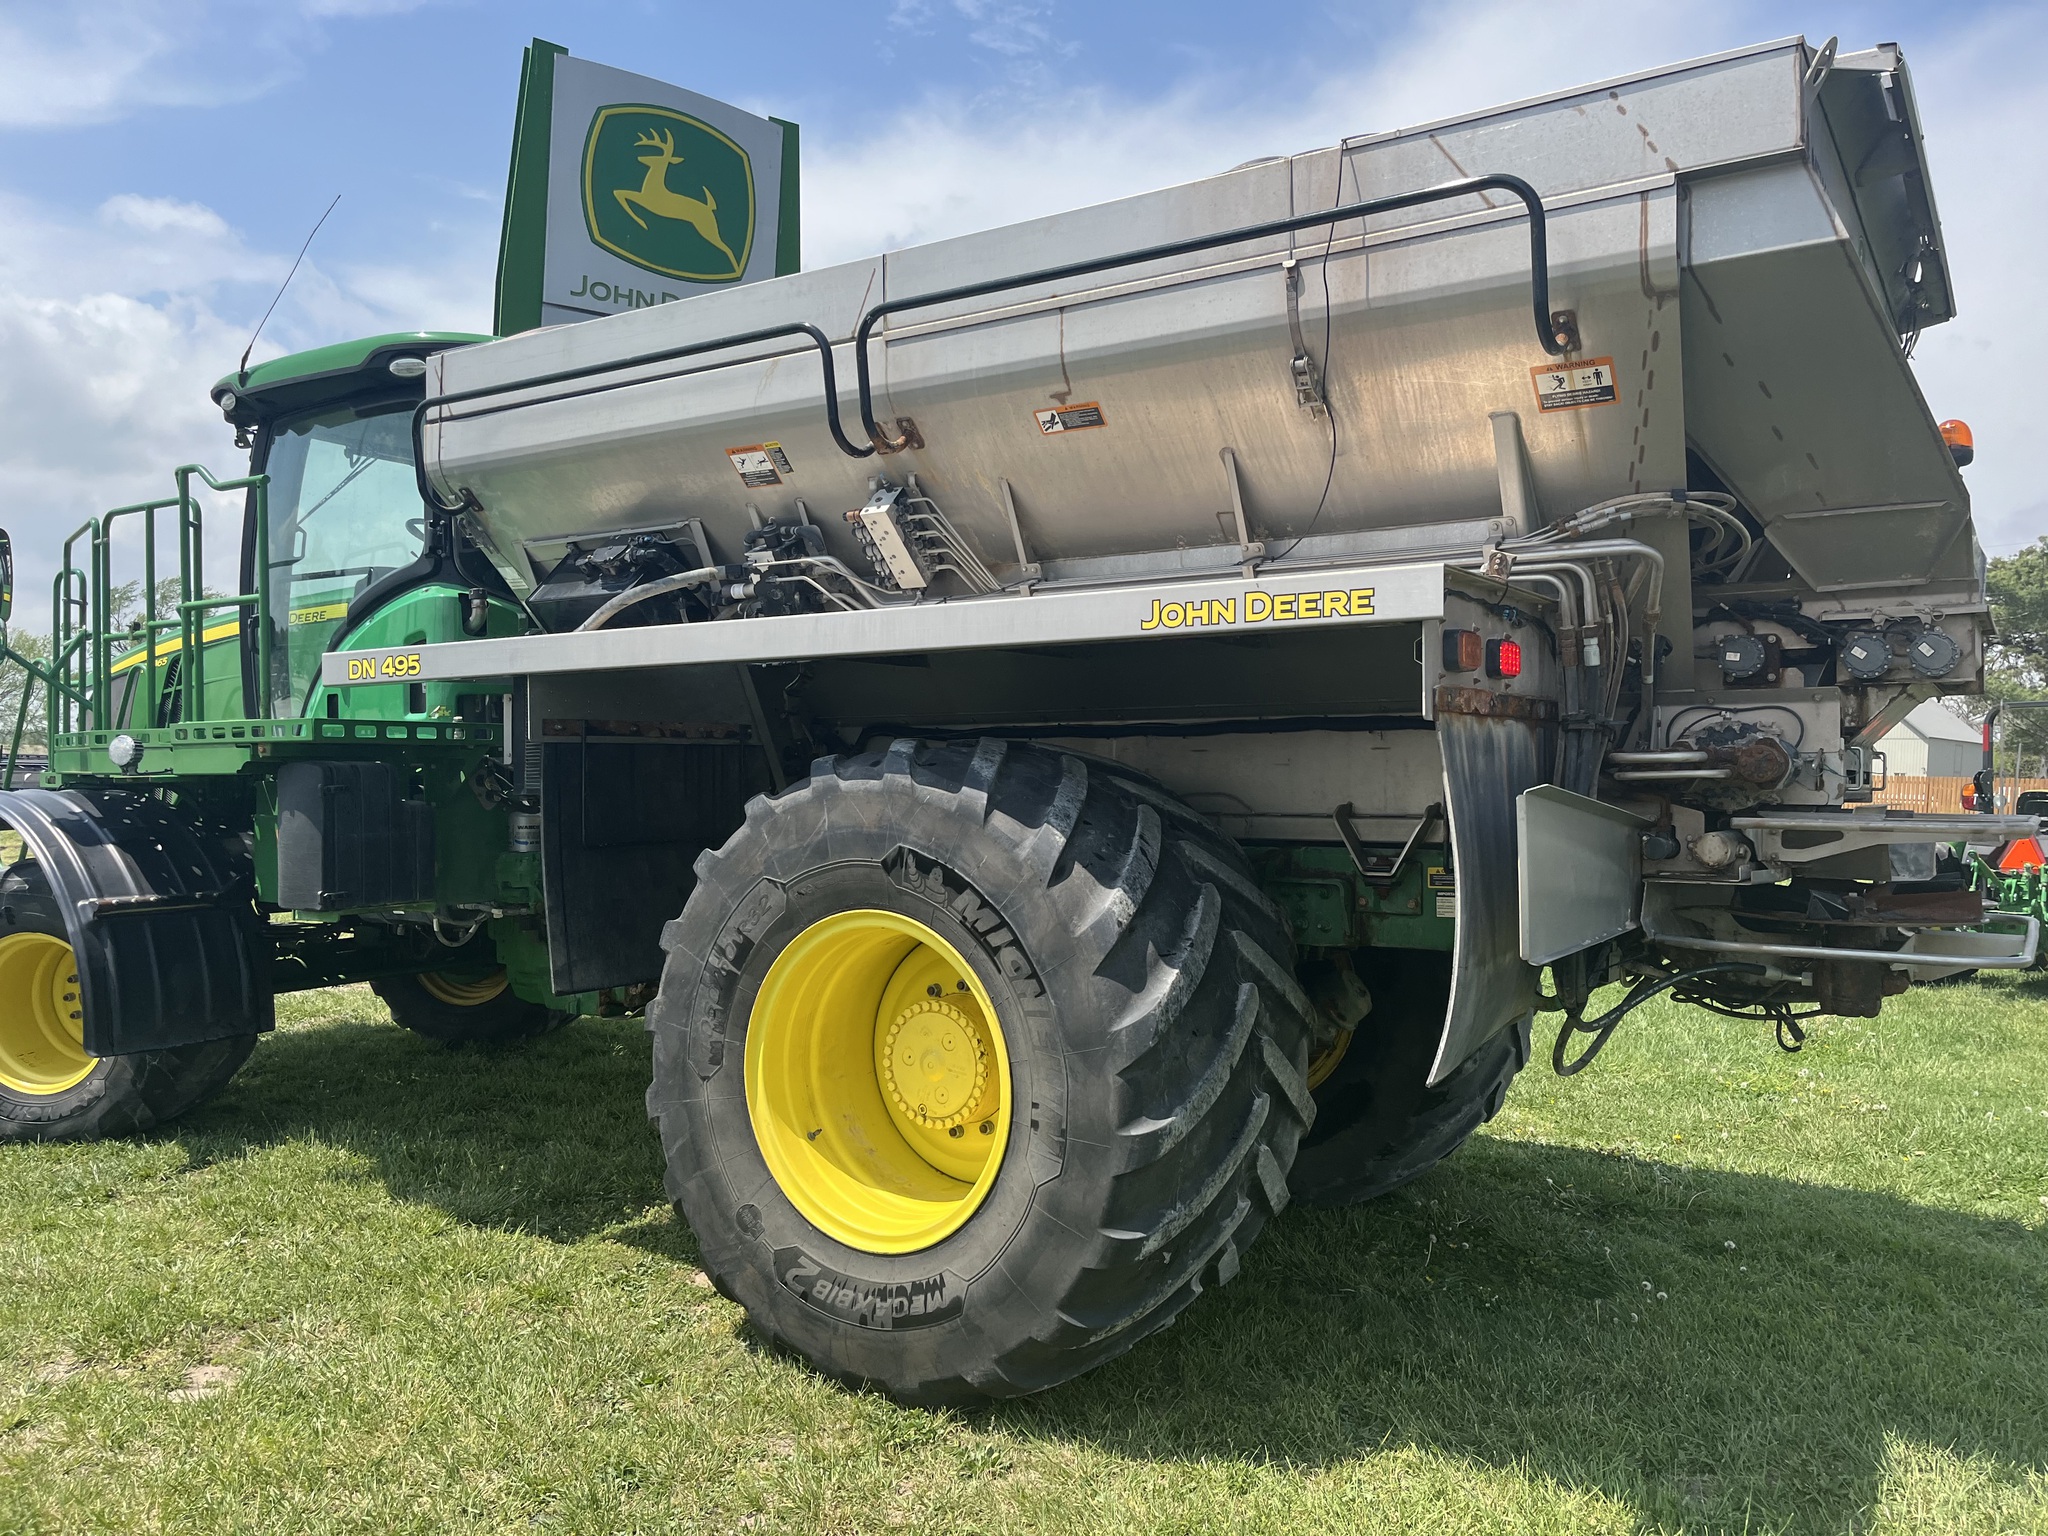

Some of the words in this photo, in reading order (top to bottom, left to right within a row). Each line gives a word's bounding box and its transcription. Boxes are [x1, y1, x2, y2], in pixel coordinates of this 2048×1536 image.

[570, 275, 655, 309] JOHN
[1555, 359, 1596, 370] WARNING
[289, 610, 327, 624] DEERE
[1141, 598, 1236, 630] JOHN
[1244, 588, 1375, 623] DEERE
[348, 658, 376, 680] DN
[381, 653, 421, 677] 495
[783, 1256, 821, 1291] 2
